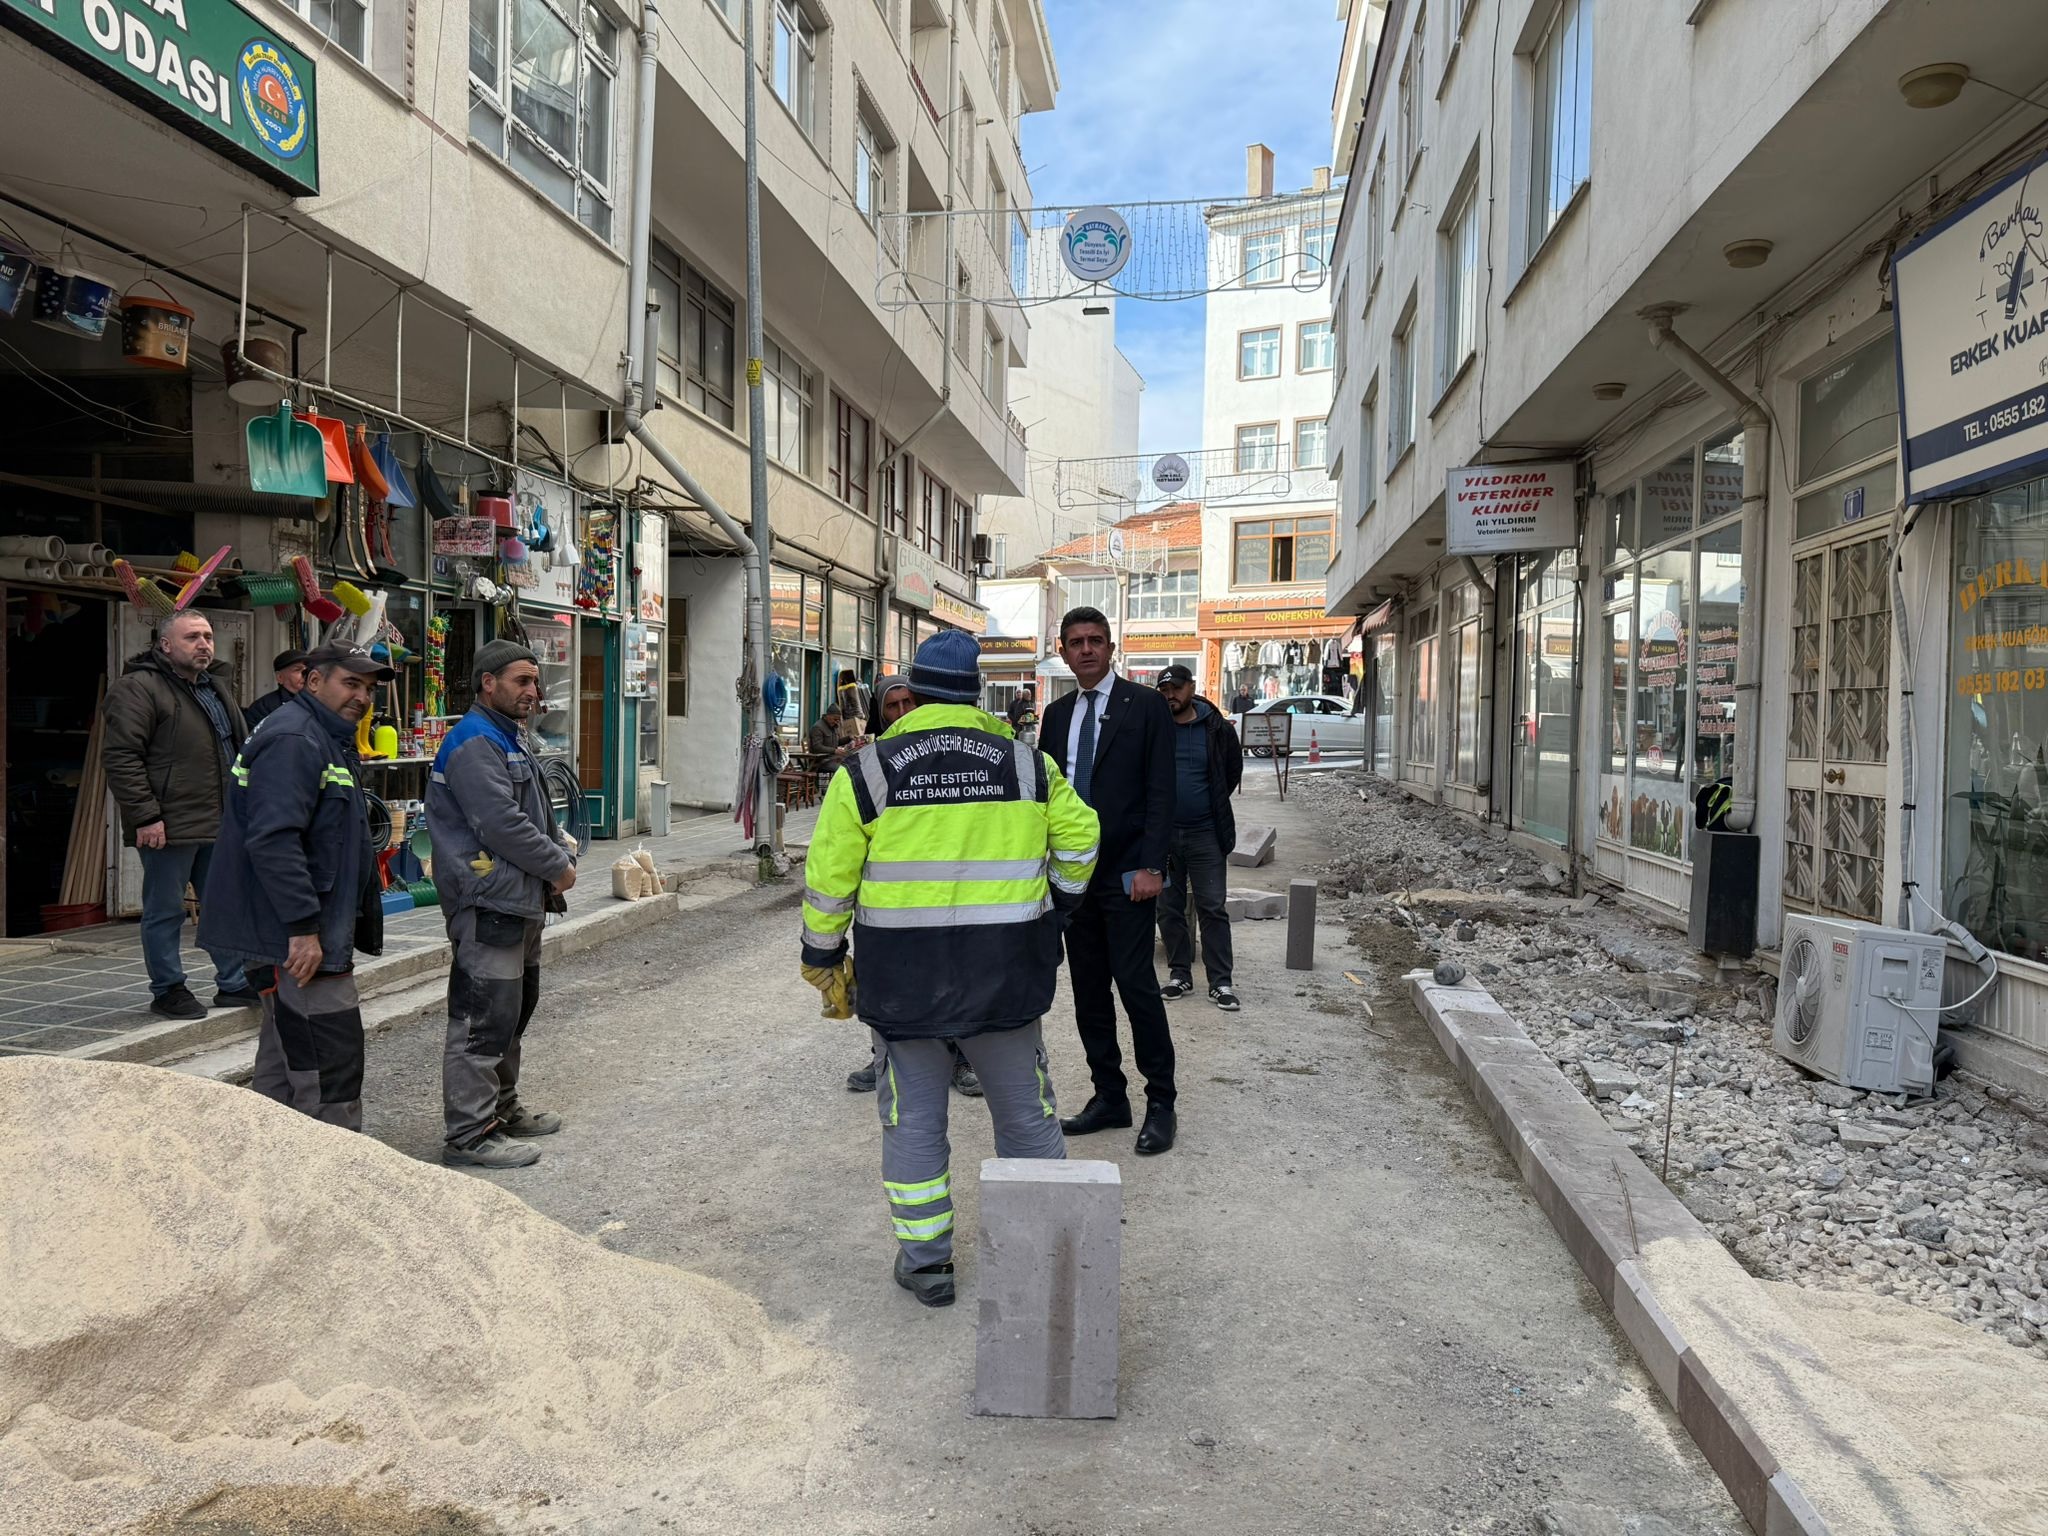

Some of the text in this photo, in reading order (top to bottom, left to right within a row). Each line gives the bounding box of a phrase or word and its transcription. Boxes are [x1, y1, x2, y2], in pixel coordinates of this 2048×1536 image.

[82, 0, 233, 126] ODASI
[259, 98, 288, 125] TZOB
[1950, 332, 2000, 376] ERKEK
[1989, 403, 2020, 432] 0555
[2021, 393, 2047, 421] 182
[1464, 472, 1546, 488] YILDIRIM
[1457, 486, 1555, 503] VETERİNER
[1471, 499, 1540, 516] KLİNİĞİ
[1475, 516, 1536, 527] Ali YILDIRIM
[1477, 526, 1535, 536] Veteriner Hekim
[1214, 612, 1246, 624] BEĞEN
[2001, 622, 2048, 648] KUAFÖR
[1957, 666, 2046, 697] 0555 182 03
[887, 733, 1008, 773] ANKARA BÜYÜKŞEHİR BELEDİYESİ
[909, 769, 989, 787] KENT ESTETİĞİ
[894, 785, 1004, 801] KENT BAKIM ONARIM
